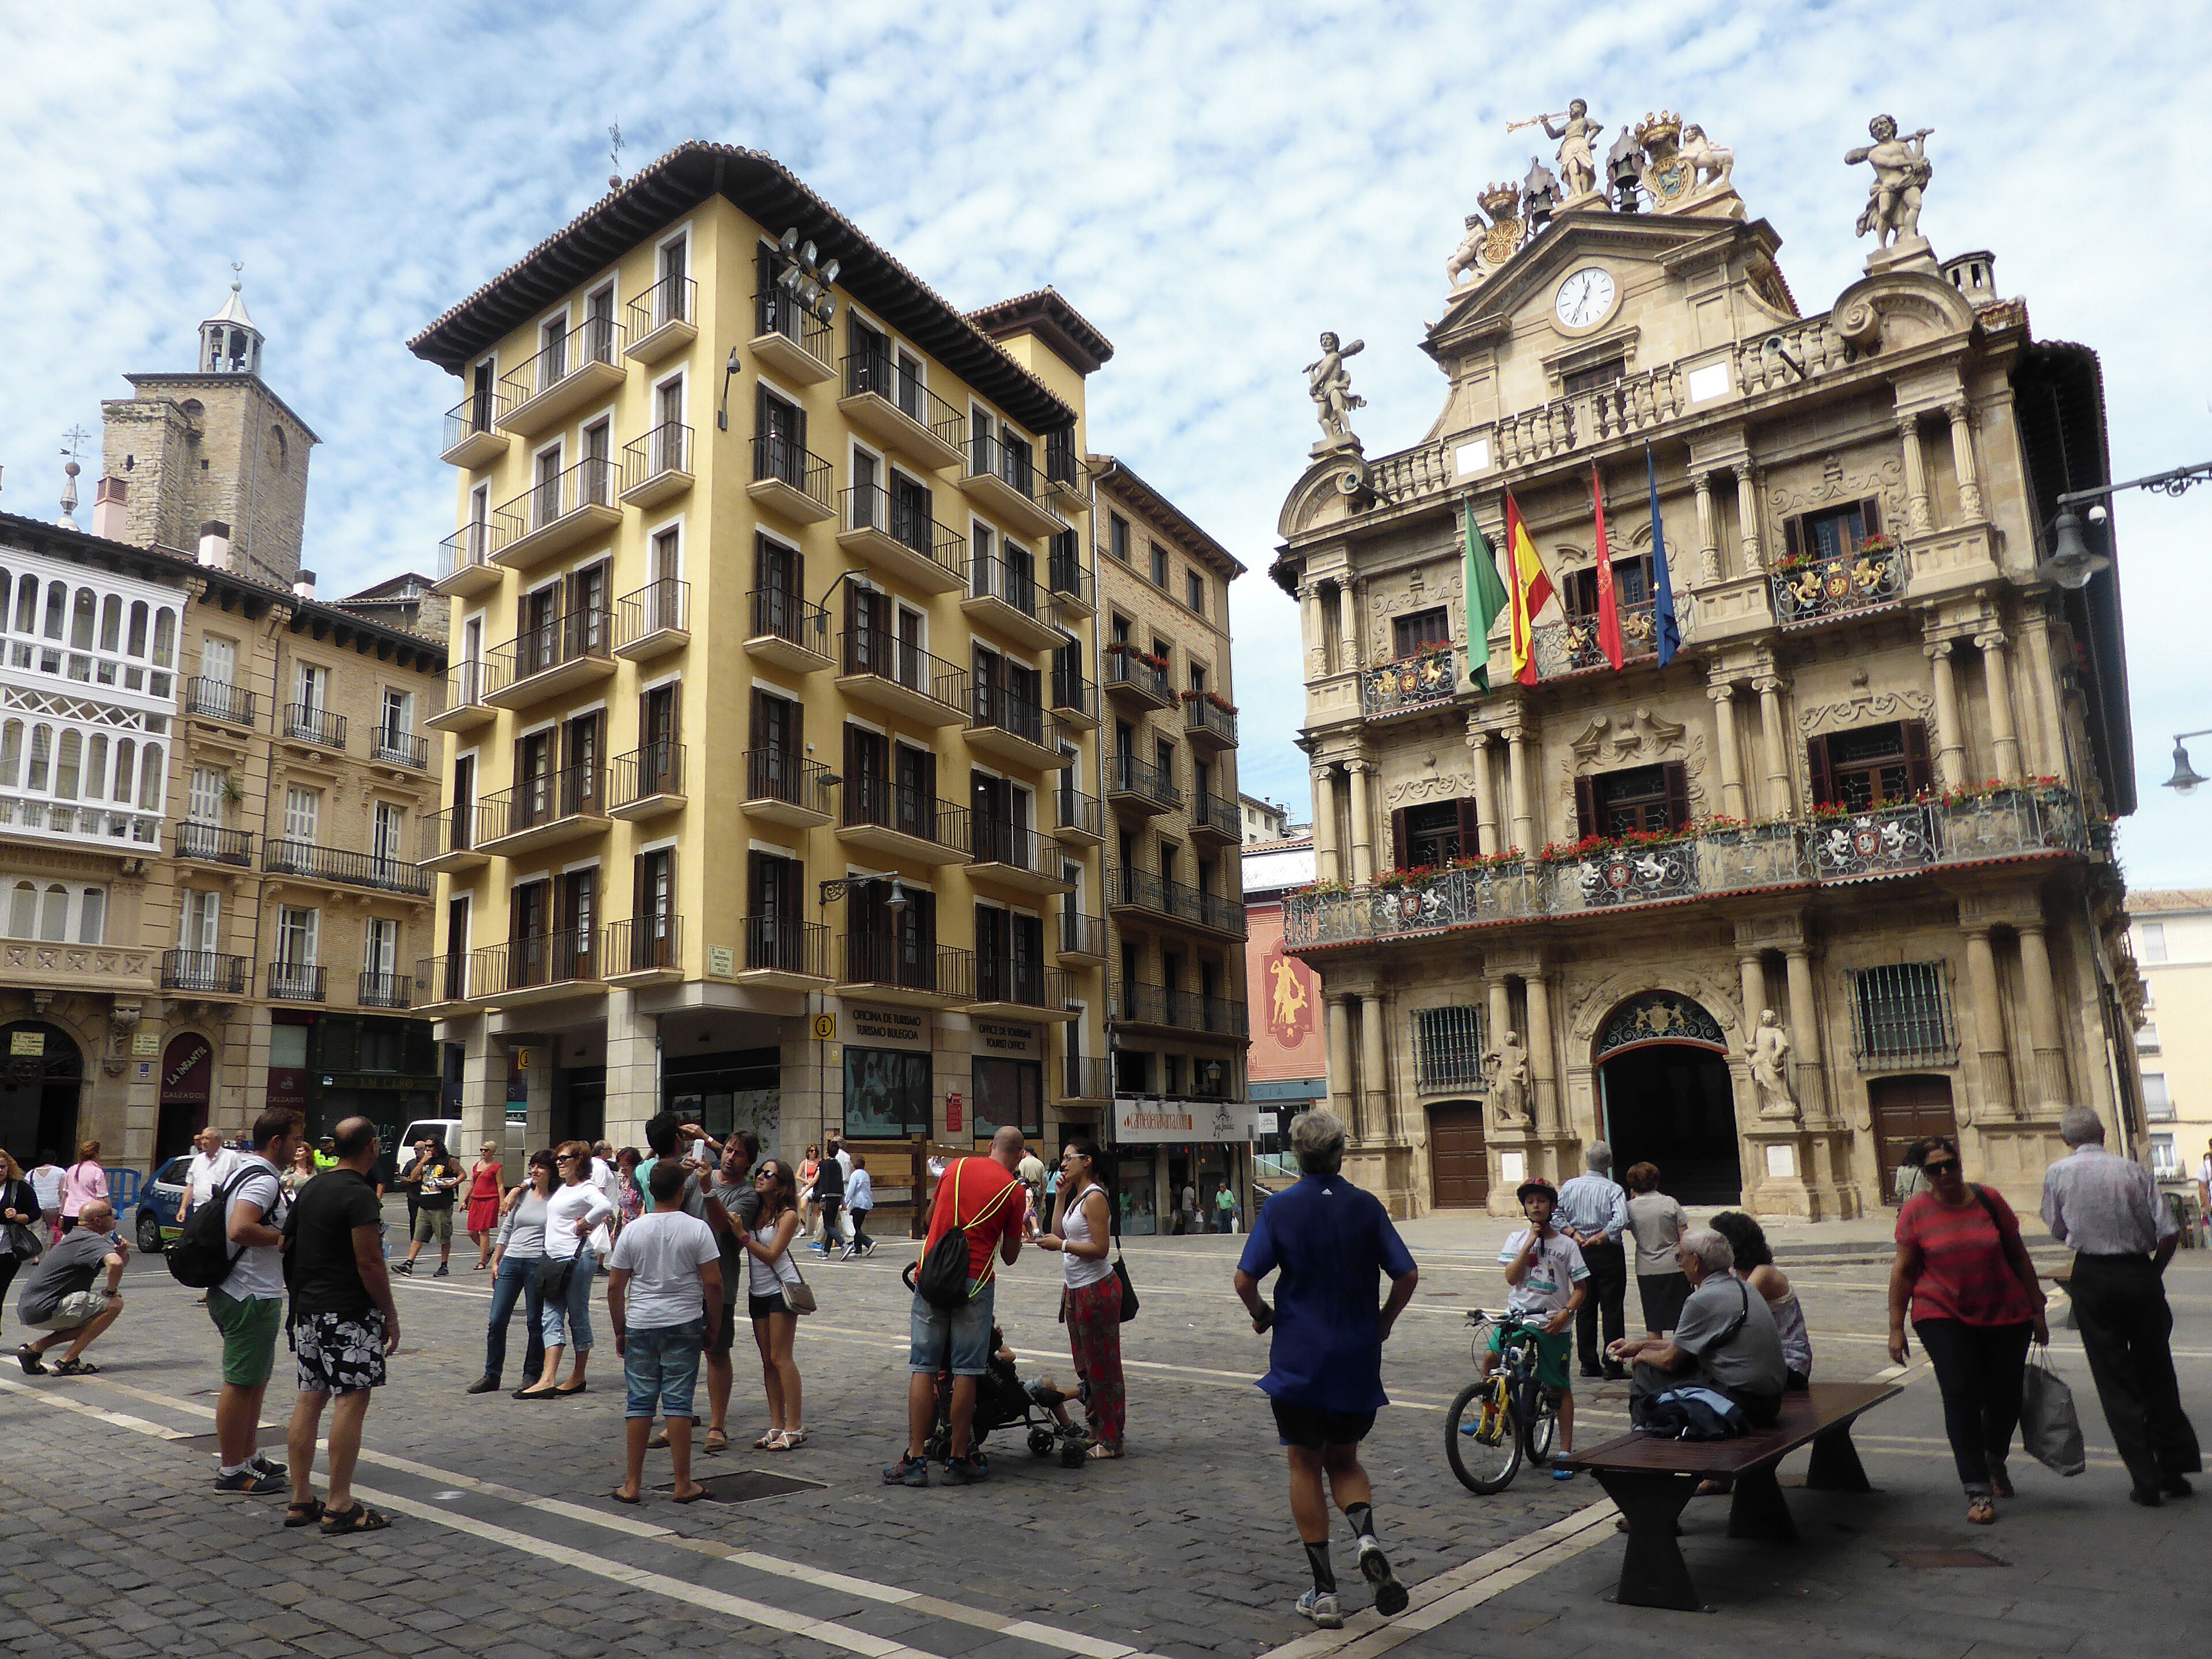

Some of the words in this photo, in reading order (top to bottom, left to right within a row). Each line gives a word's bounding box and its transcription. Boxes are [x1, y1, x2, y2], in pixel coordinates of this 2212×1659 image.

[853, 1010, 882, 1022] OFICINA
[883, 1013, 892, 1023] DE
[893, 1014, 921, 1027] TURISMO
[856, 1024, 886, 1037] TURISMO
[887, 1028, 919, 1040] BULEGOA
[979, 1024, 999, 1035] OFFICE
[999, 1027, 1006, 1036] DE
[1007, 1027, 1032, 1039] TOURISME
[986, 1038, 1006, 1048] TOURIST
[1007, 1040, 1026, 1051] OFFICE
[166, 1074, 180, 1085] LA
[175, 1046, 207, 1075] INFANTIL
